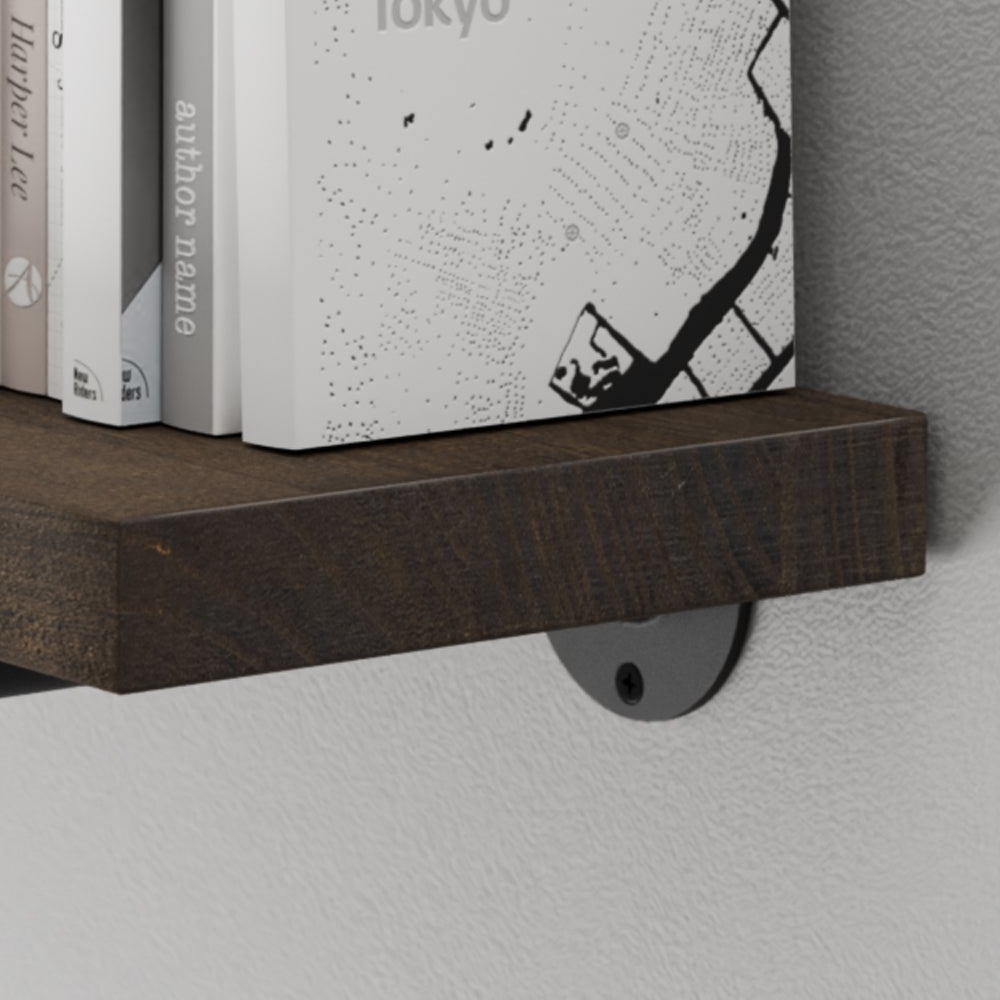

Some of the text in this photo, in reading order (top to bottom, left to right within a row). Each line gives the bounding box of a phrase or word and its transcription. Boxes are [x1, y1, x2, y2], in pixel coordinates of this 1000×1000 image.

[5, 14, 34, 139] Harper
[10, 143, 35, 202] Lee
[174, 100, 203, 337] author name
